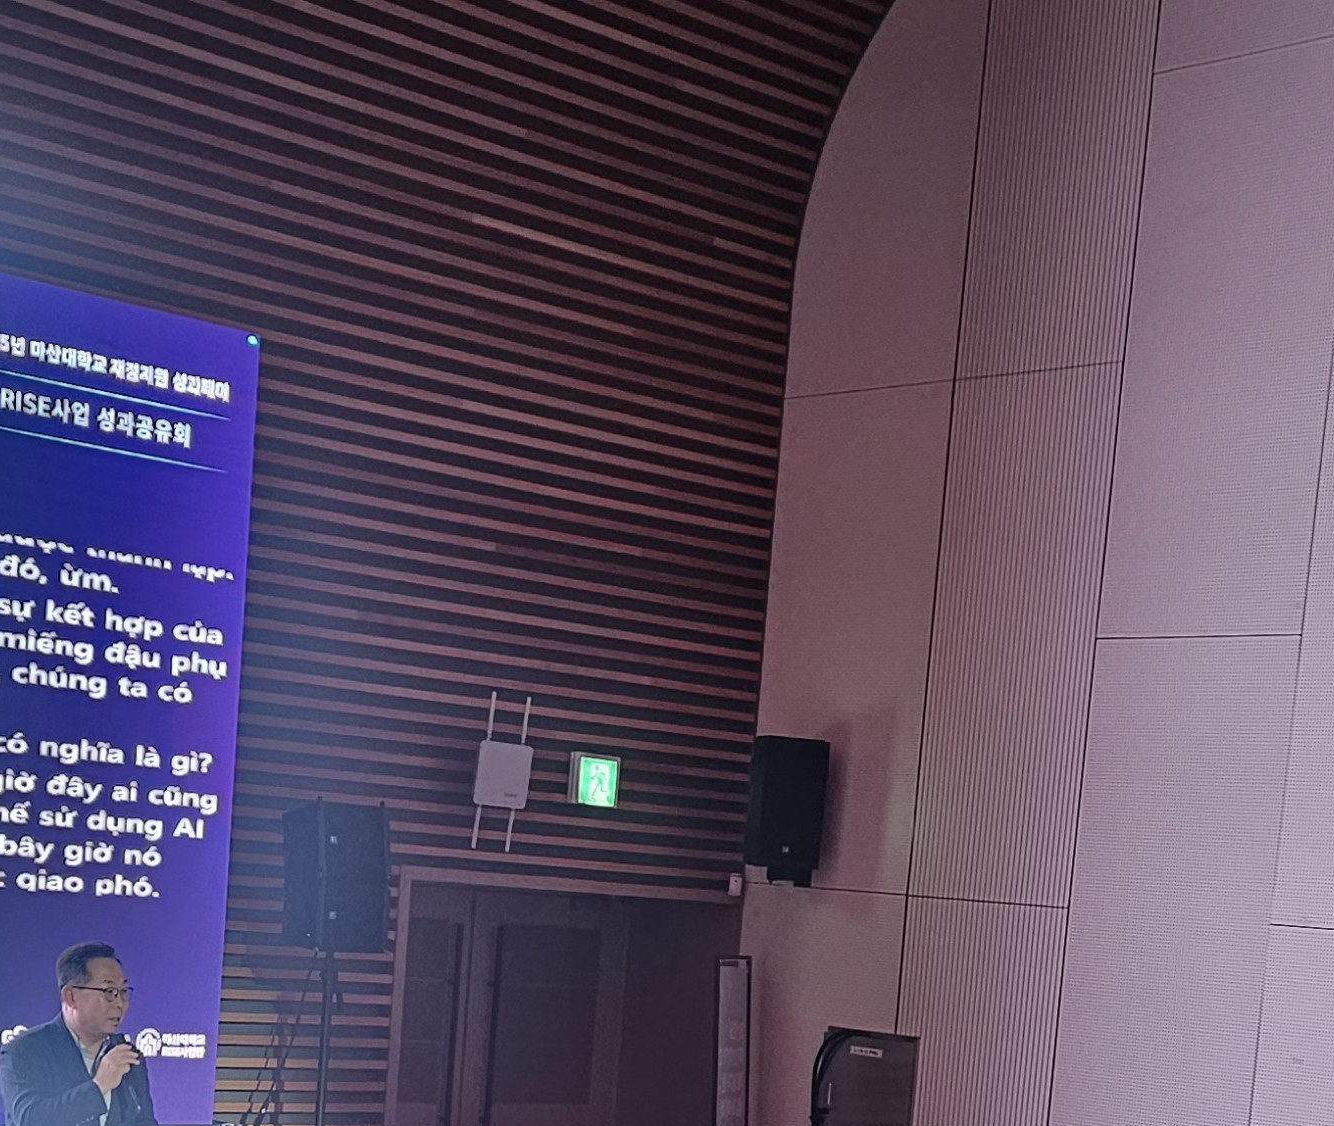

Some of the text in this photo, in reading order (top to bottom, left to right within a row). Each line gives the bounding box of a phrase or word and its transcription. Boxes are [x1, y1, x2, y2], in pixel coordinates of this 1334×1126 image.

[30, 340, 108, 373] 마산대학교
[109, 356, 169, 389] 재정지원
[172, 371, 231, 403] 성과페어
[0, 387, 192, 449] RISE사업 성과공유회
[60, 563, 119, 594] ừm.
[45, 599, 95, 629] kết
[104, 608, 163, 641] hợp
[172, 621, 224, 646] của
[104, 641, 161, 670] đậu
[171, 651, 228, 680] phụ
[11, 662, 107, 699] chúng
[117, 676, 148, 699] ta
[157, 681, 194, 704] có
[40, 739, 125, 765] nghĩa
[135, 744, 161, 769] là
[171, 750, 213, 776] gì?
[46, 773, 103, 804] đây
[111, 780, 139, 803] ai
[147, 785, 219, 816] cũng
[39, 805, 79, 829] sử
[86, 810, 163, 841] dụng
[173, 817, 205, 840] AI
[63, 840, 115, 867] giờ
[124, 844, 163, 868] nó
[95, 873, 161, 898] phó.
